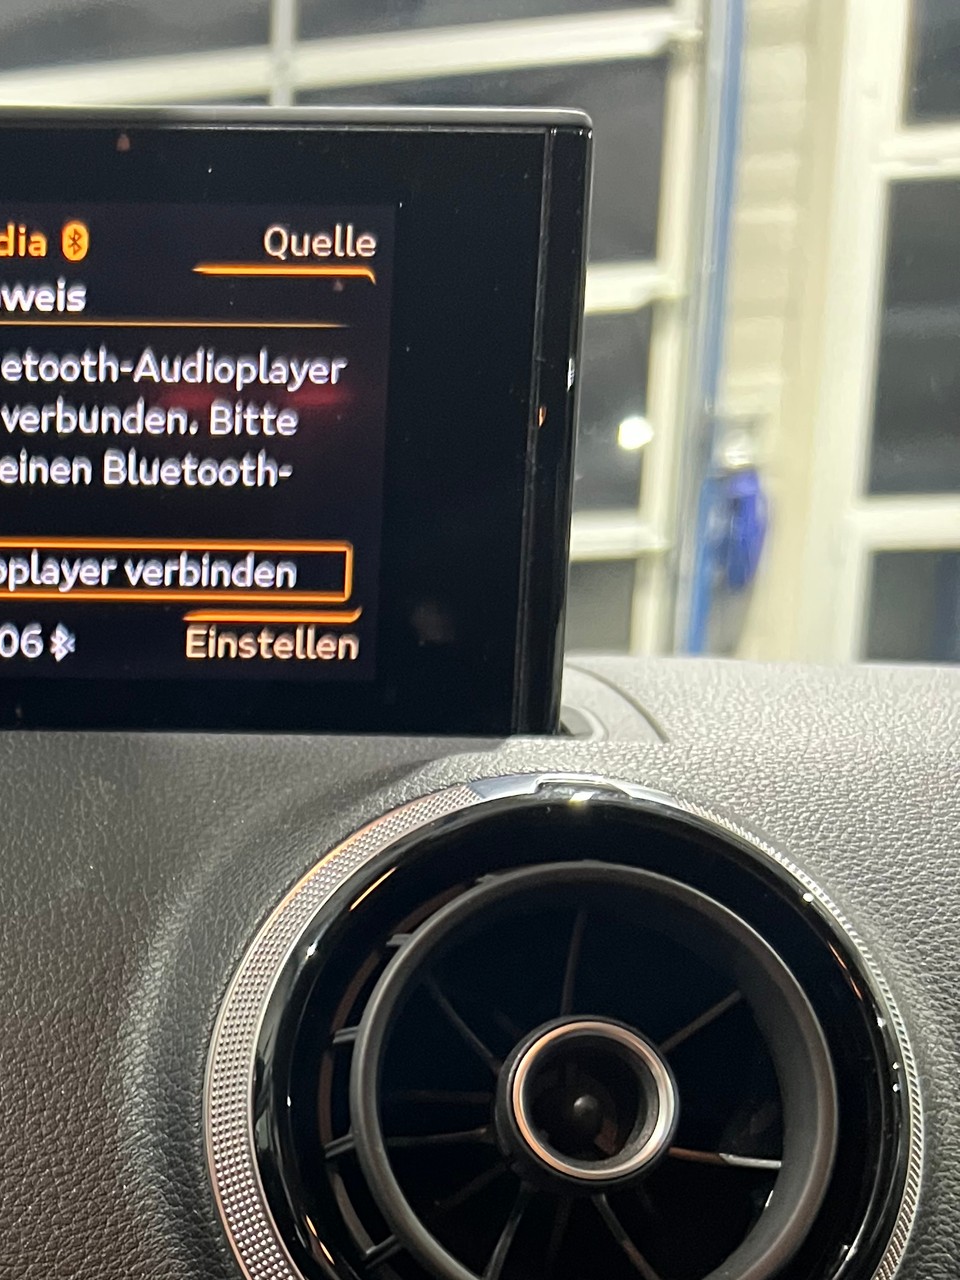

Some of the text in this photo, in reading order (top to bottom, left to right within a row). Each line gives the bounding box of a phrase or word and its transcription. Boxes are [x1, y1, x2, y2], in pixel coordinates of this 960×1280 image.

[264, 226, 377, 260] Quelle
[1, 395, 198, 435] verbunden.
[210, 401, 298, 436] Bitte
[103, 449, 292, 488] Bluetooth-
[124, 551, 297, 589] verbinden
[185, 624, 359, 661] Einstellen
